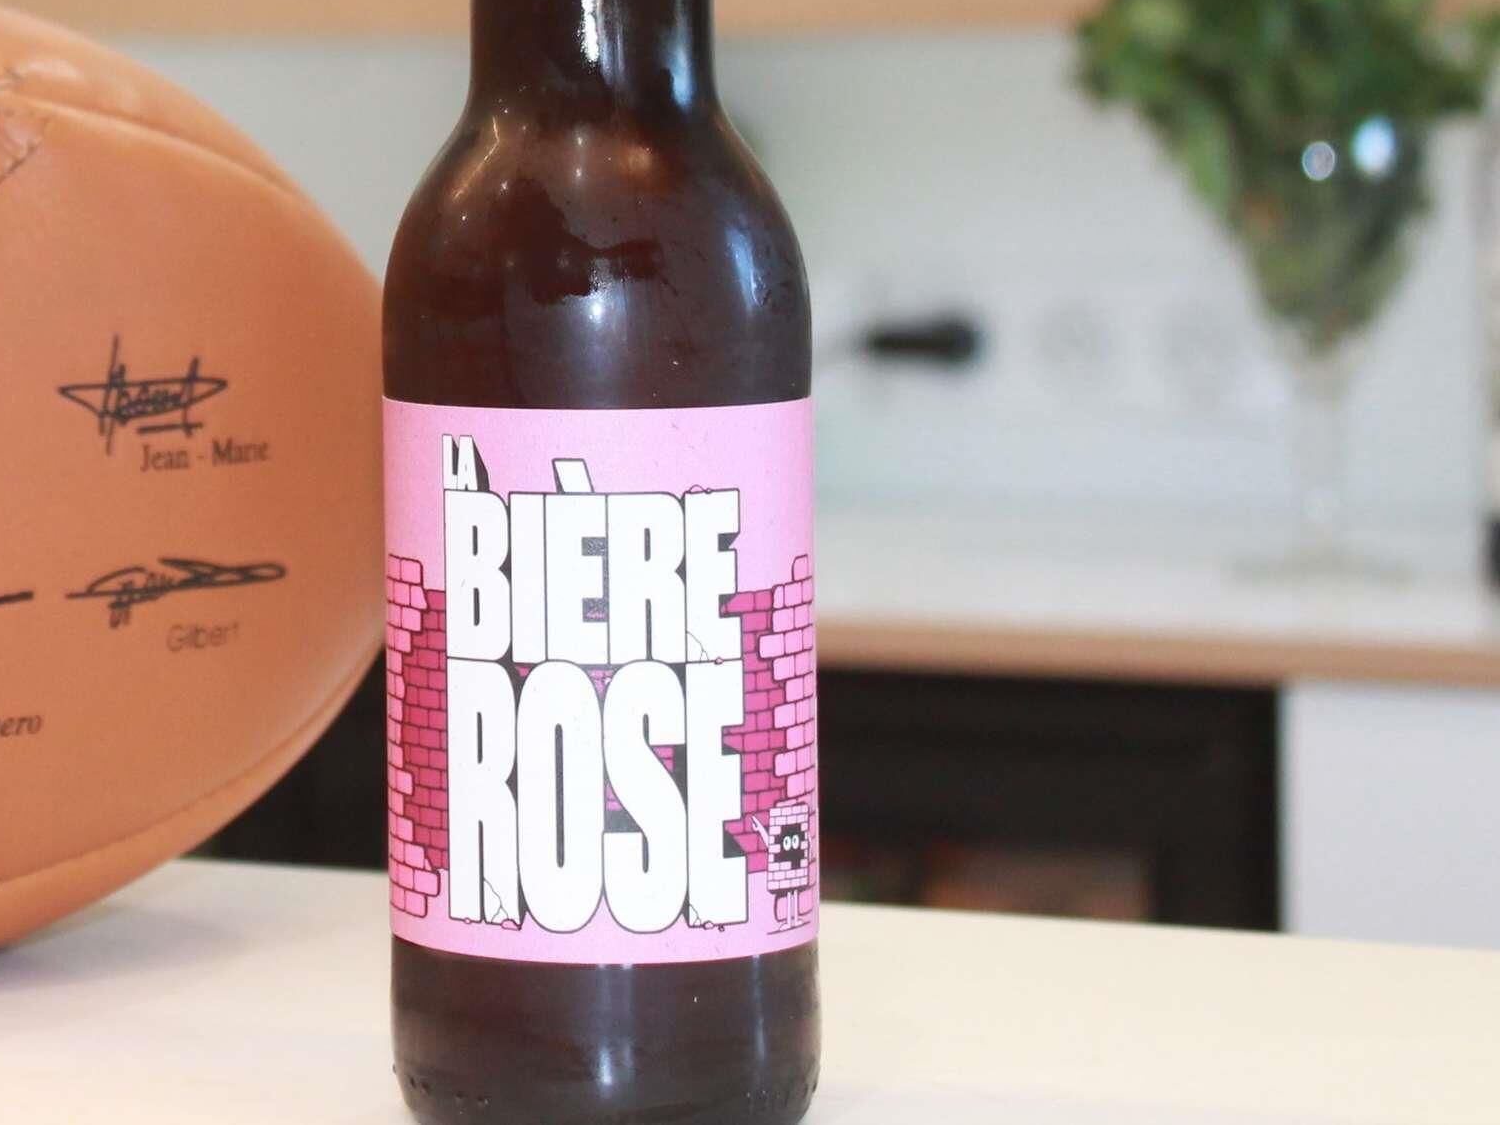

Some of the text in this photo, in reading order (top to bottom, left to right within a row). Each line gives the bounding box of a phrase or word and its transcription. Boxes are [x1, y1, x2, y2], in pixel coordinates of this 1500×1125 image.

[140, 444, 190, 472] Jean
[442, 433, 489, 492] LA
[442, 458, 742, 664] BIÈRE
[446, 659, 750, 934] ROSE
